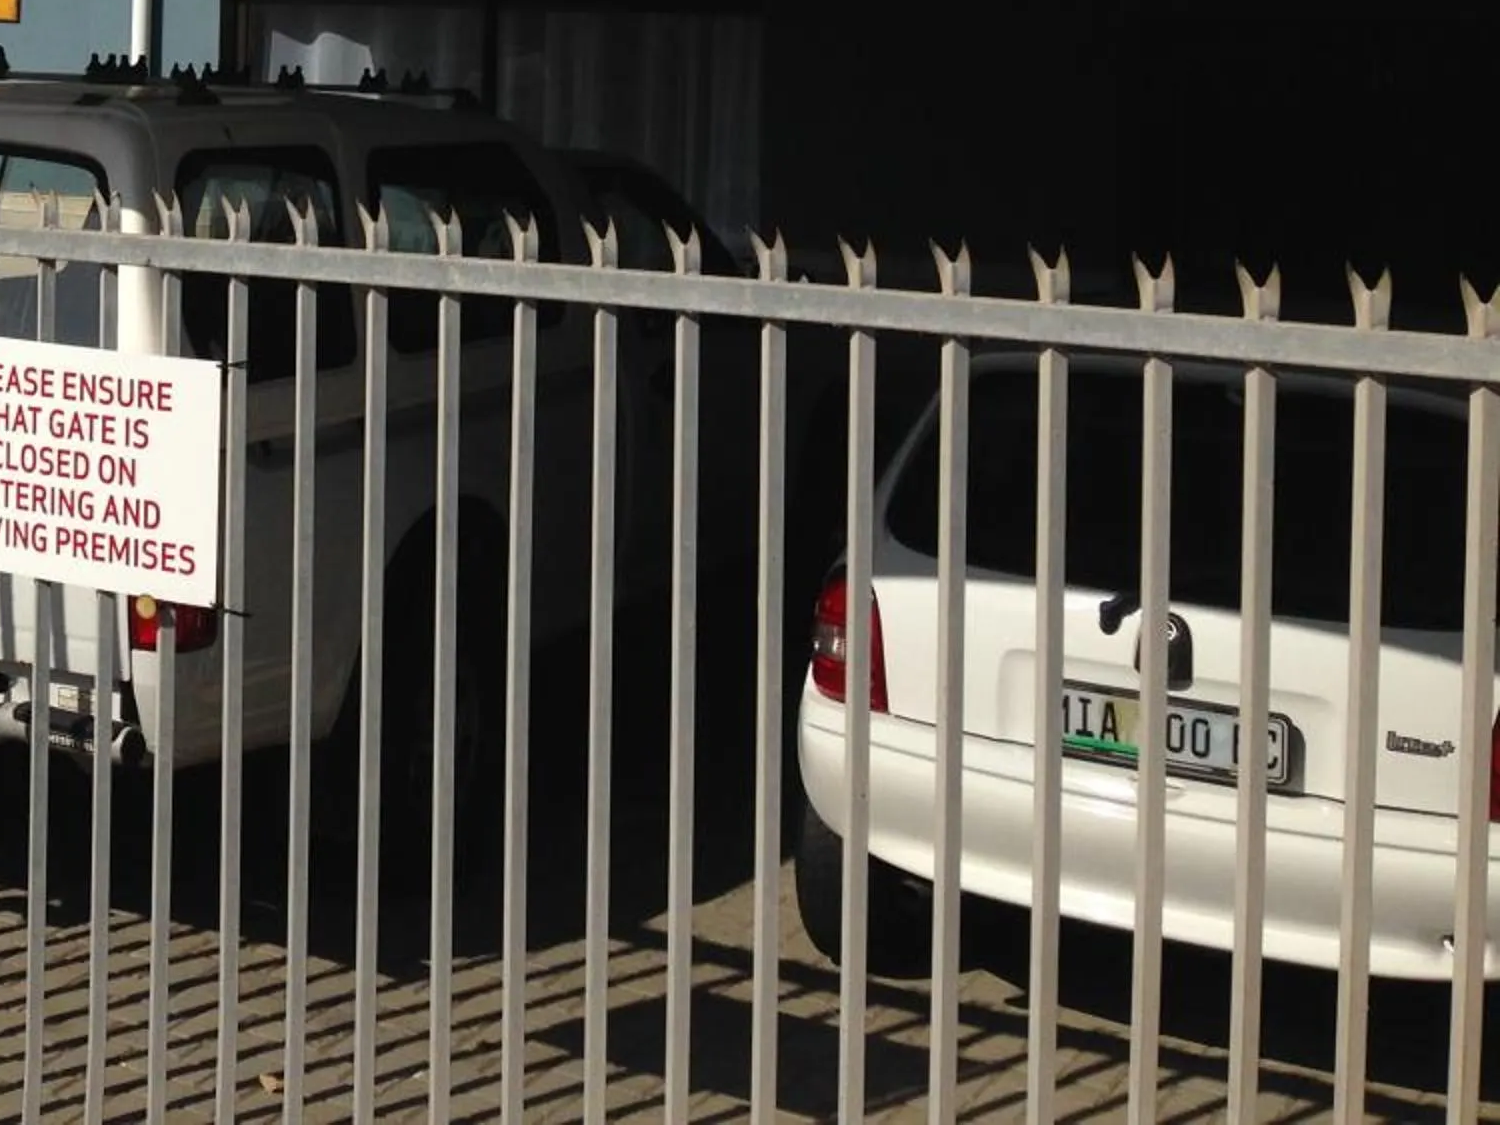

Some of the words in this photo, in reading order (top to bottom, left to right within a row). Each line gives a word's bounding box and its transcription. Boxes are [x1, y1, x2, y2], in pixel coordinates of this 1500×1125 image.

[63, 371, 173, 412] ENSURE
[49, 409, 116, 445] GATE
[124, 417, 149, 449] IS
[98, 454, 137, 488] ON
[102, 494, 161, 530] AND
[56, 526, 197, 576] PREMISES
